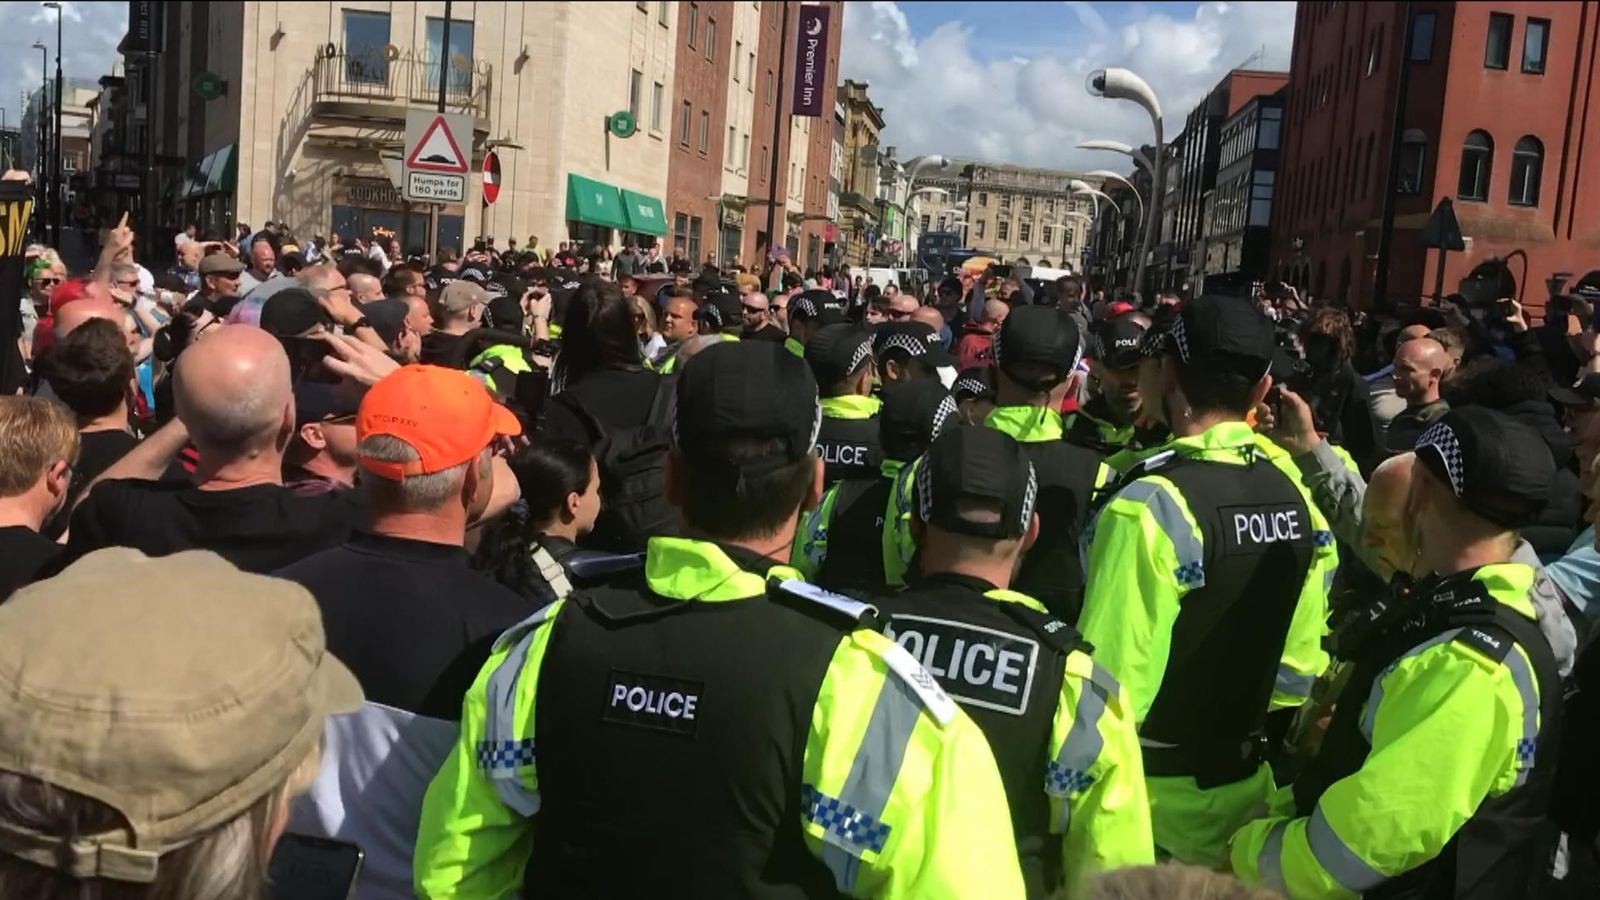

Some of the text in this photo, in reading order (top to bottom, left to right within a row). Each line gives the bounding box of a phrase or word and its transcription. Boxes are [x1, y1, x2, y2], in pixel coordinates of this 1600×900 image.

[803, 39, 819, 106] Premier Inn
[413, 176, 444, 186] Humps
[434, 187, 458, 197] yards
[815, 444, 868, 466] OLICE
[1233, 510, 1302, 545] POLICE
[611, 683, 698, 720] POLICE
